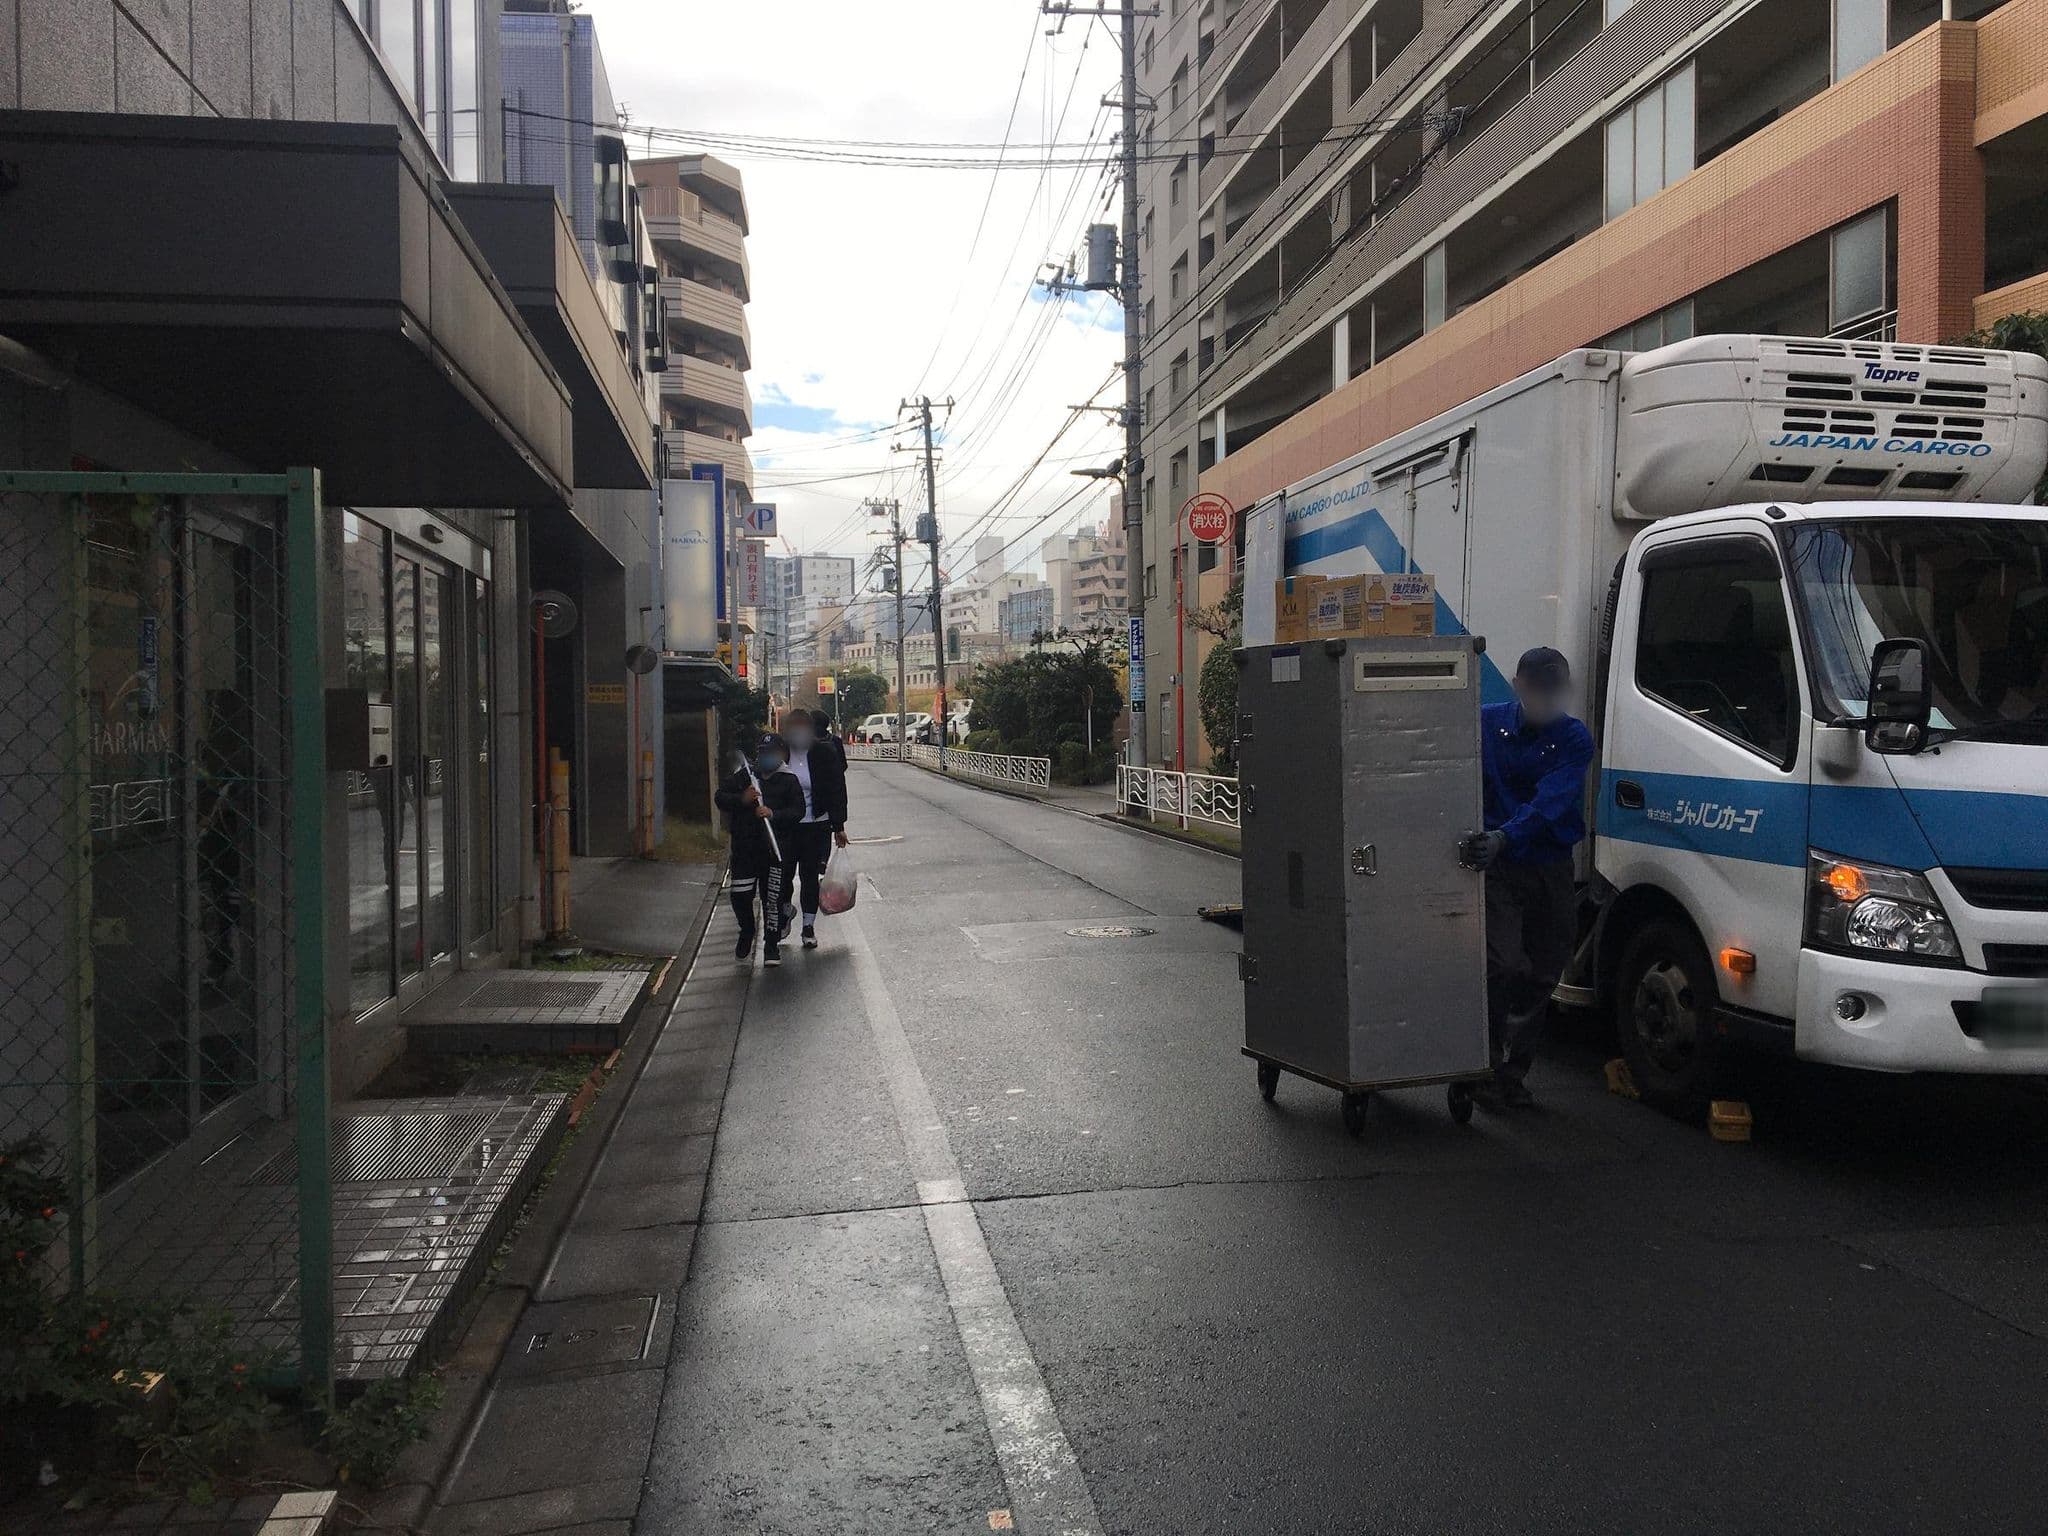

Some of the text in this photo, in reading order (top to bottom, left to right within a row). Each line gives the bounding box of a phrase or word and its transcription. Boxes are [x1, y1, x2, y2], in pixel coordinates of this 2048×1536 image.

[1864, 362, 1920, 383] Topre
[1769, 433, 1992, 458] JAPAN CARGO
[757, 508, 774, 531] P
[1300, 496, 1332, 520] CARGO
[1192, 512, 1225, 529] 消火栓
